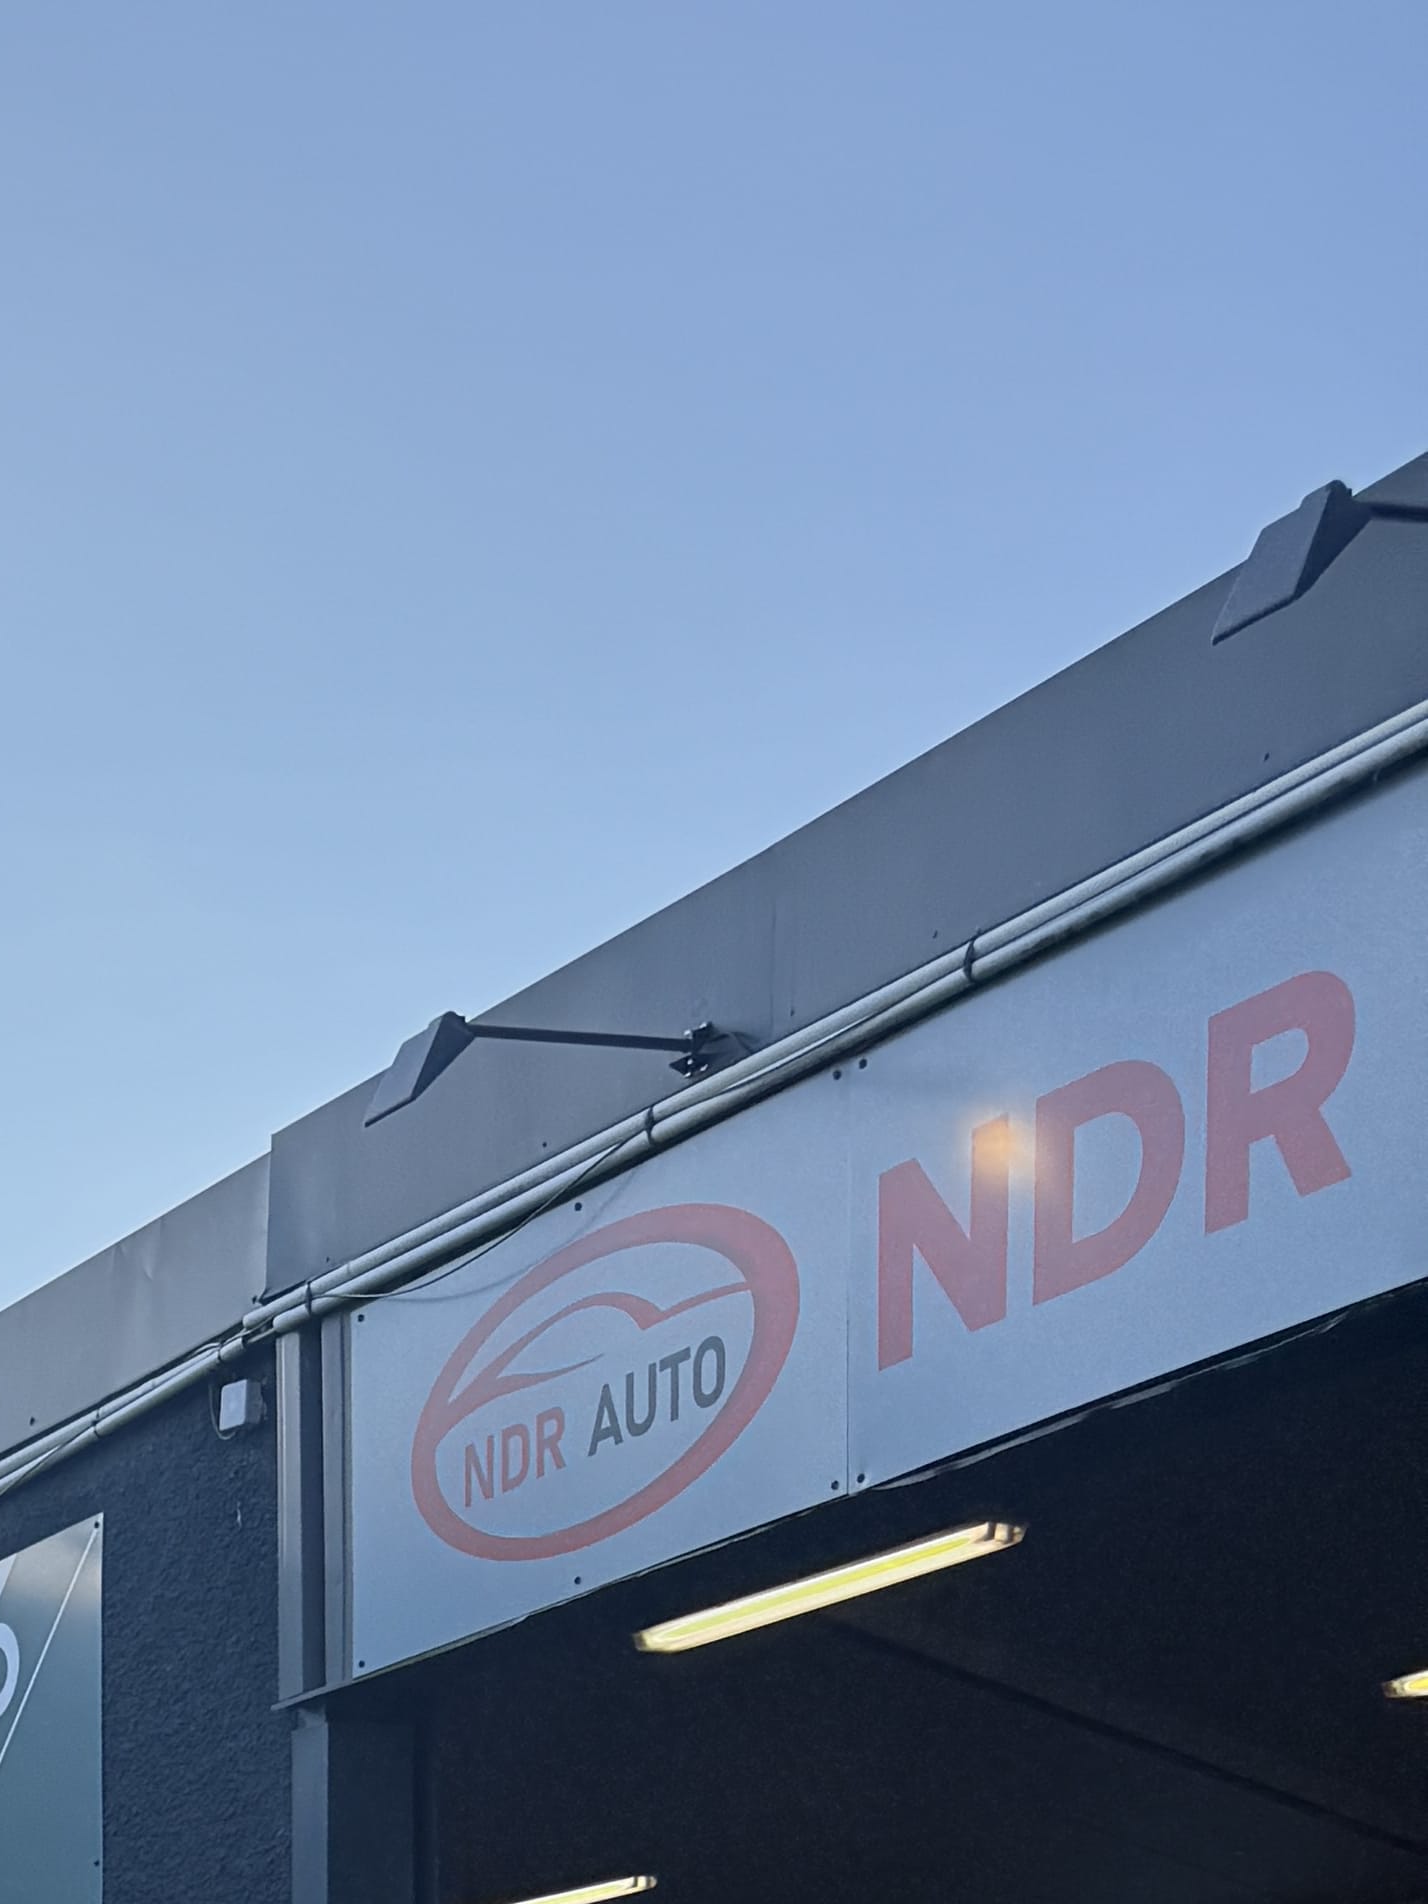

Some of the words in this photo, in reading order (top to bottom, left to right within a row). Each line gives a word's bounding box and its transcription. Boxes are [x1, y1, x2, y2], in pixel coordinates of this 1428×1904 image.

[877, 970, 1356, 1371] NDR
[461, 1405, 566, 1508] NDR
[587, 1334, 726, 1457] AUTO
